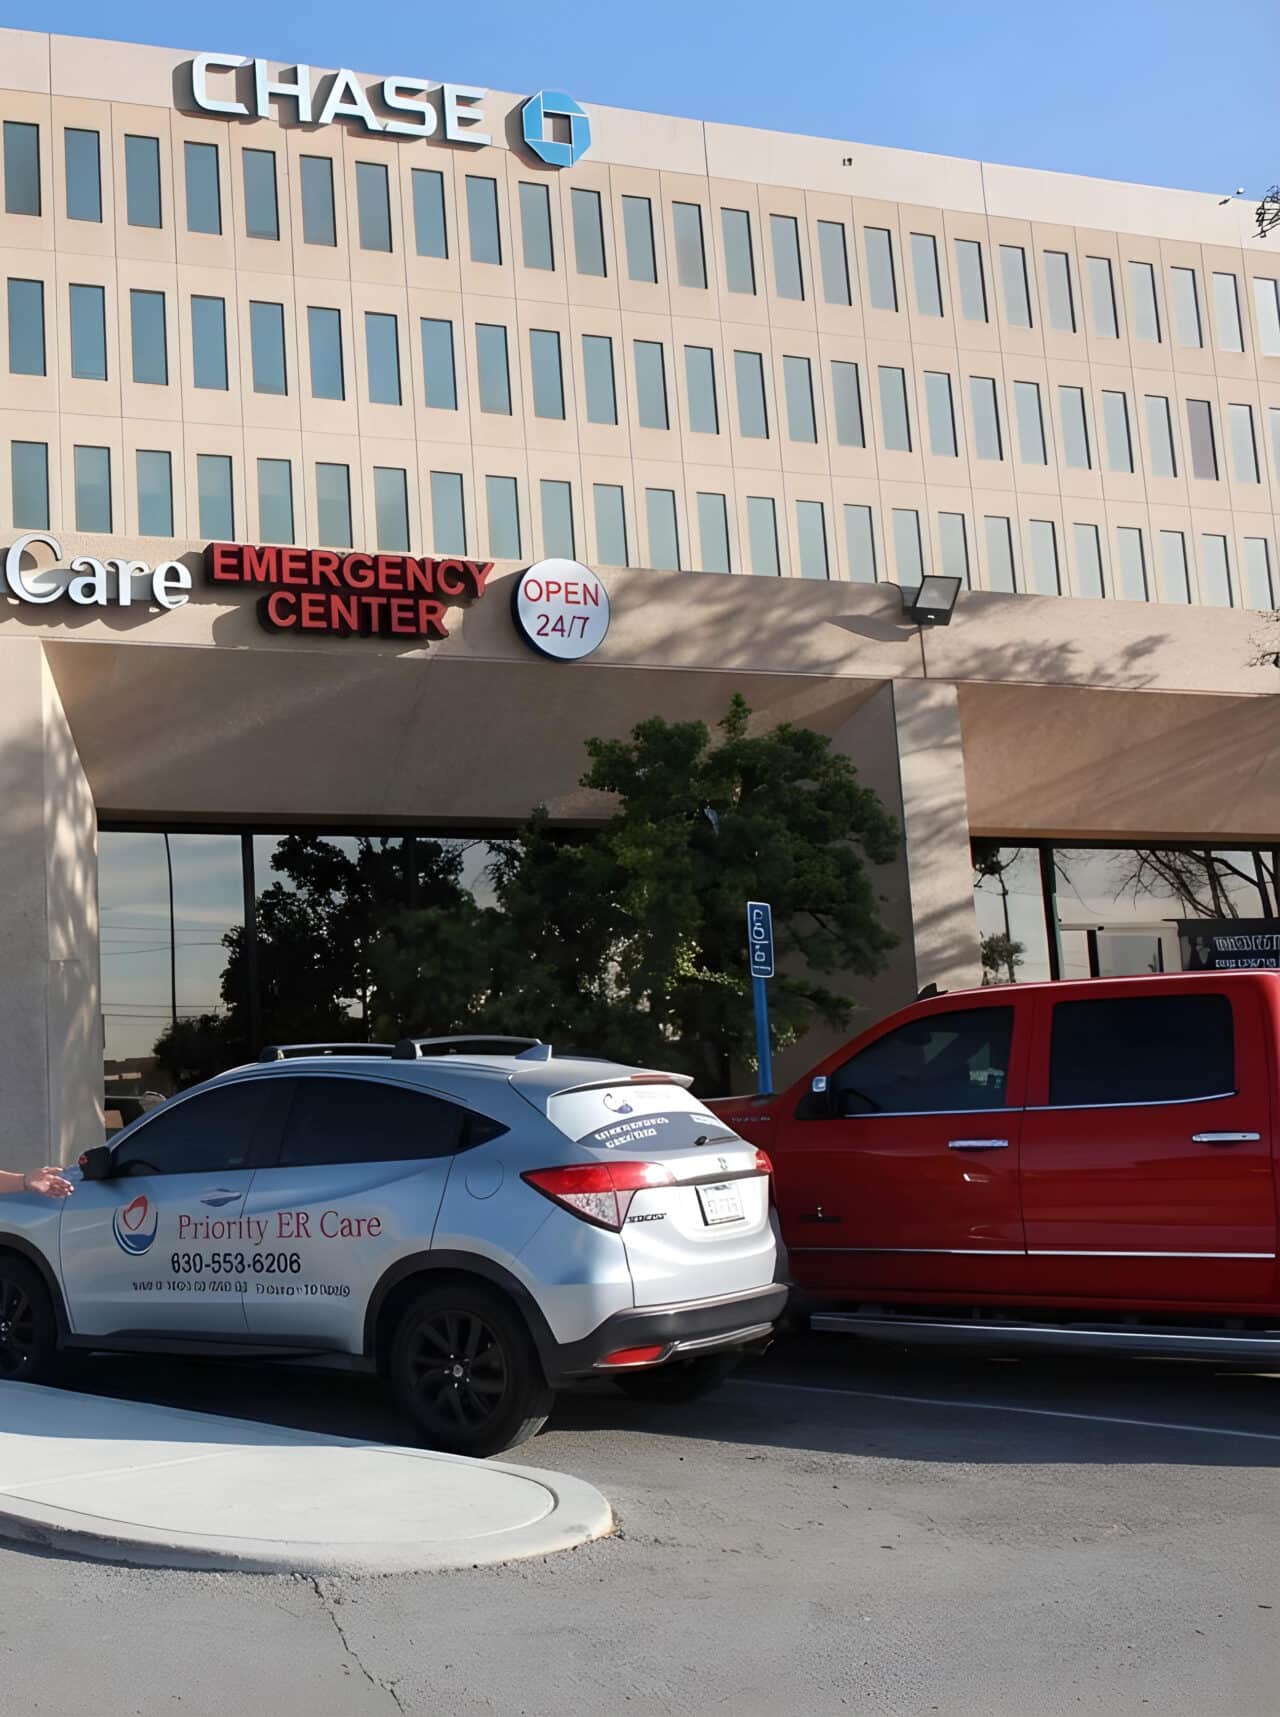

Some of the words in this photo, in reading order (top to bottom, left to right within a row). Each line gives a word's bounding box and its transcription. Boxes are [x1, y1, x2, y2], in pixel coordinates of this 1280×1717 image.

[191, 52, 492, 146] CHASE
[5, 531, 193, 610] Care
[210, 543, 496, 598] EMERGENCY
[523, 578, 601, 607] OPEN
[266, 590, 450, 637] CENTER
[535, 613, 591, 640] 24/7
[178, 1214, 268, 1246] Priority
[276, 1211, 312, 1239] ER
[320, 1210, 383, 1239] Care
